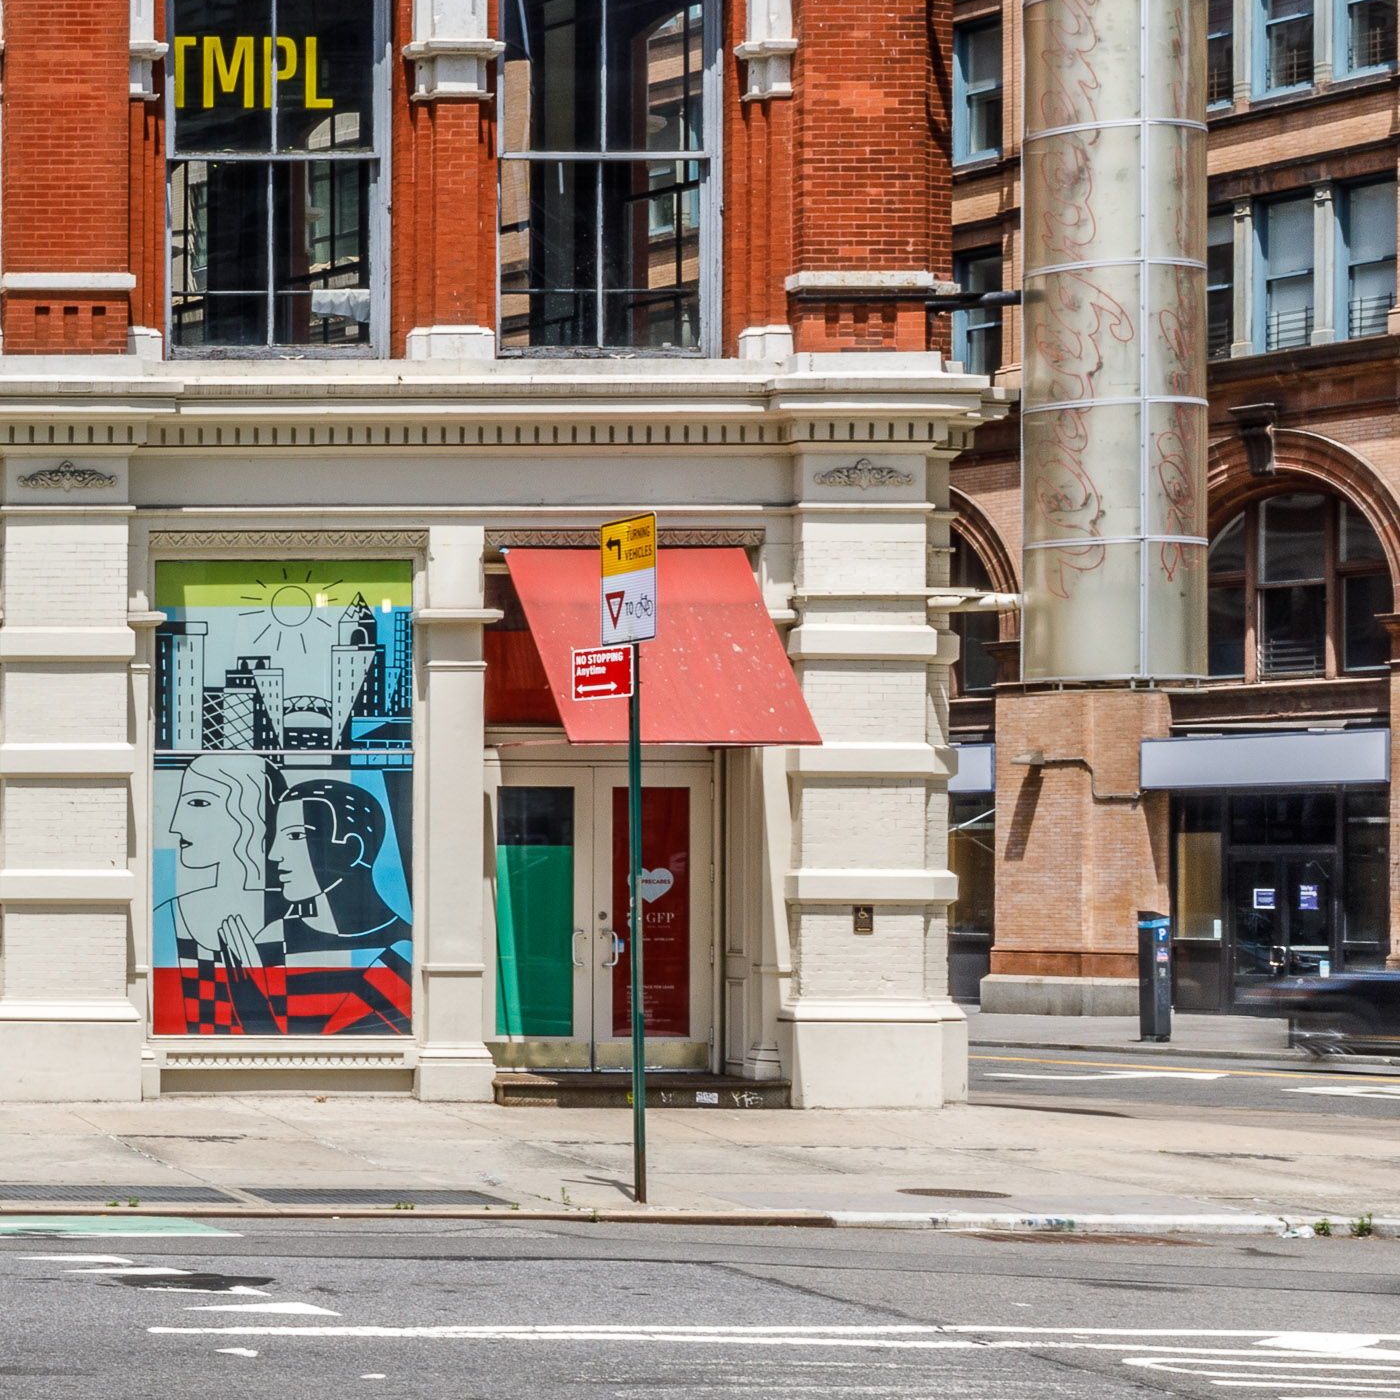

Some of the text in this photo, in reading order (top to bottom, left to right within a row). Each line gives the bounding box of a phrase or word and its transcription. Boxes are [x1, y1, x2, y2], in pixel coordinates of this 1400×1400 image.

[174, 36, 334, 108] TMPL
[626, 525, 650, 542] TURNING
[625, 544, 652, 561] VEHICLES
[625, 601, 634, 616] TO
[575, 651, 624, 666] NO STOPPING
[576, 665, 607, 678] Anytime
[646, 912, 675, 924] GFP
